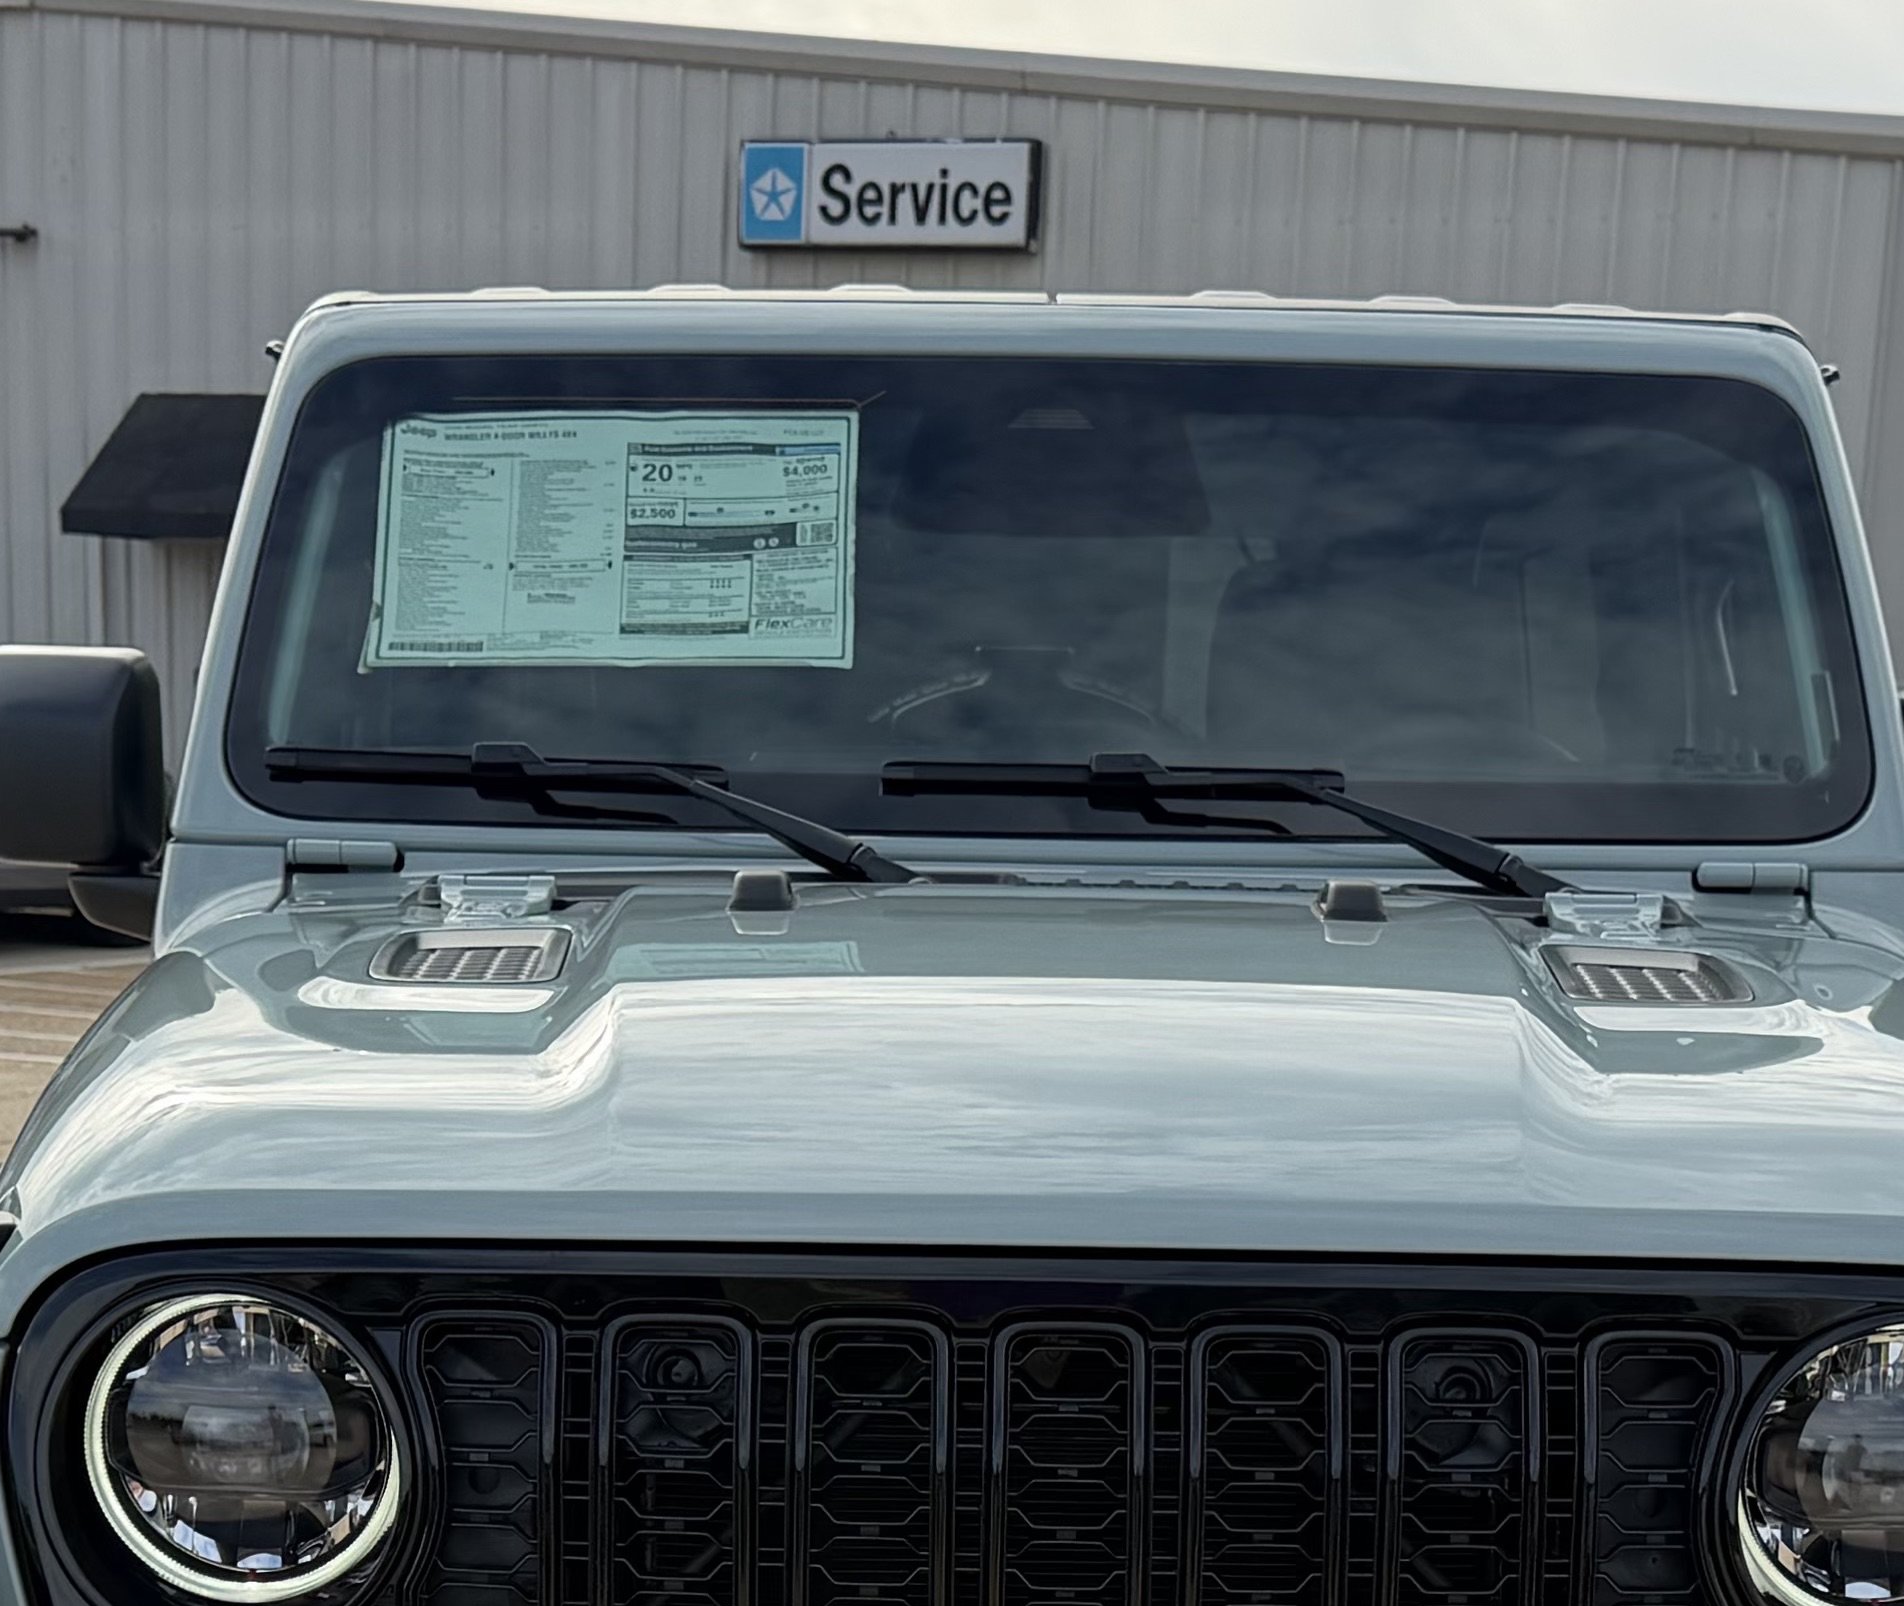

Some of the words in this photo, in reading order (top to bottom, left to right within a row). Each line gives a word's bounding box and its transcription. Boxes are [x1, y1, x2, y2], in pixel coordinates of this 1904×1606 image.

[817, 163, 1013, 227] Service
[641, 463, 673, 482] 20
[782, 463, 828, 478] $4,000
[630, 507, 676, 519] $2,500
[754, 617, 833, 630] FlexCare
